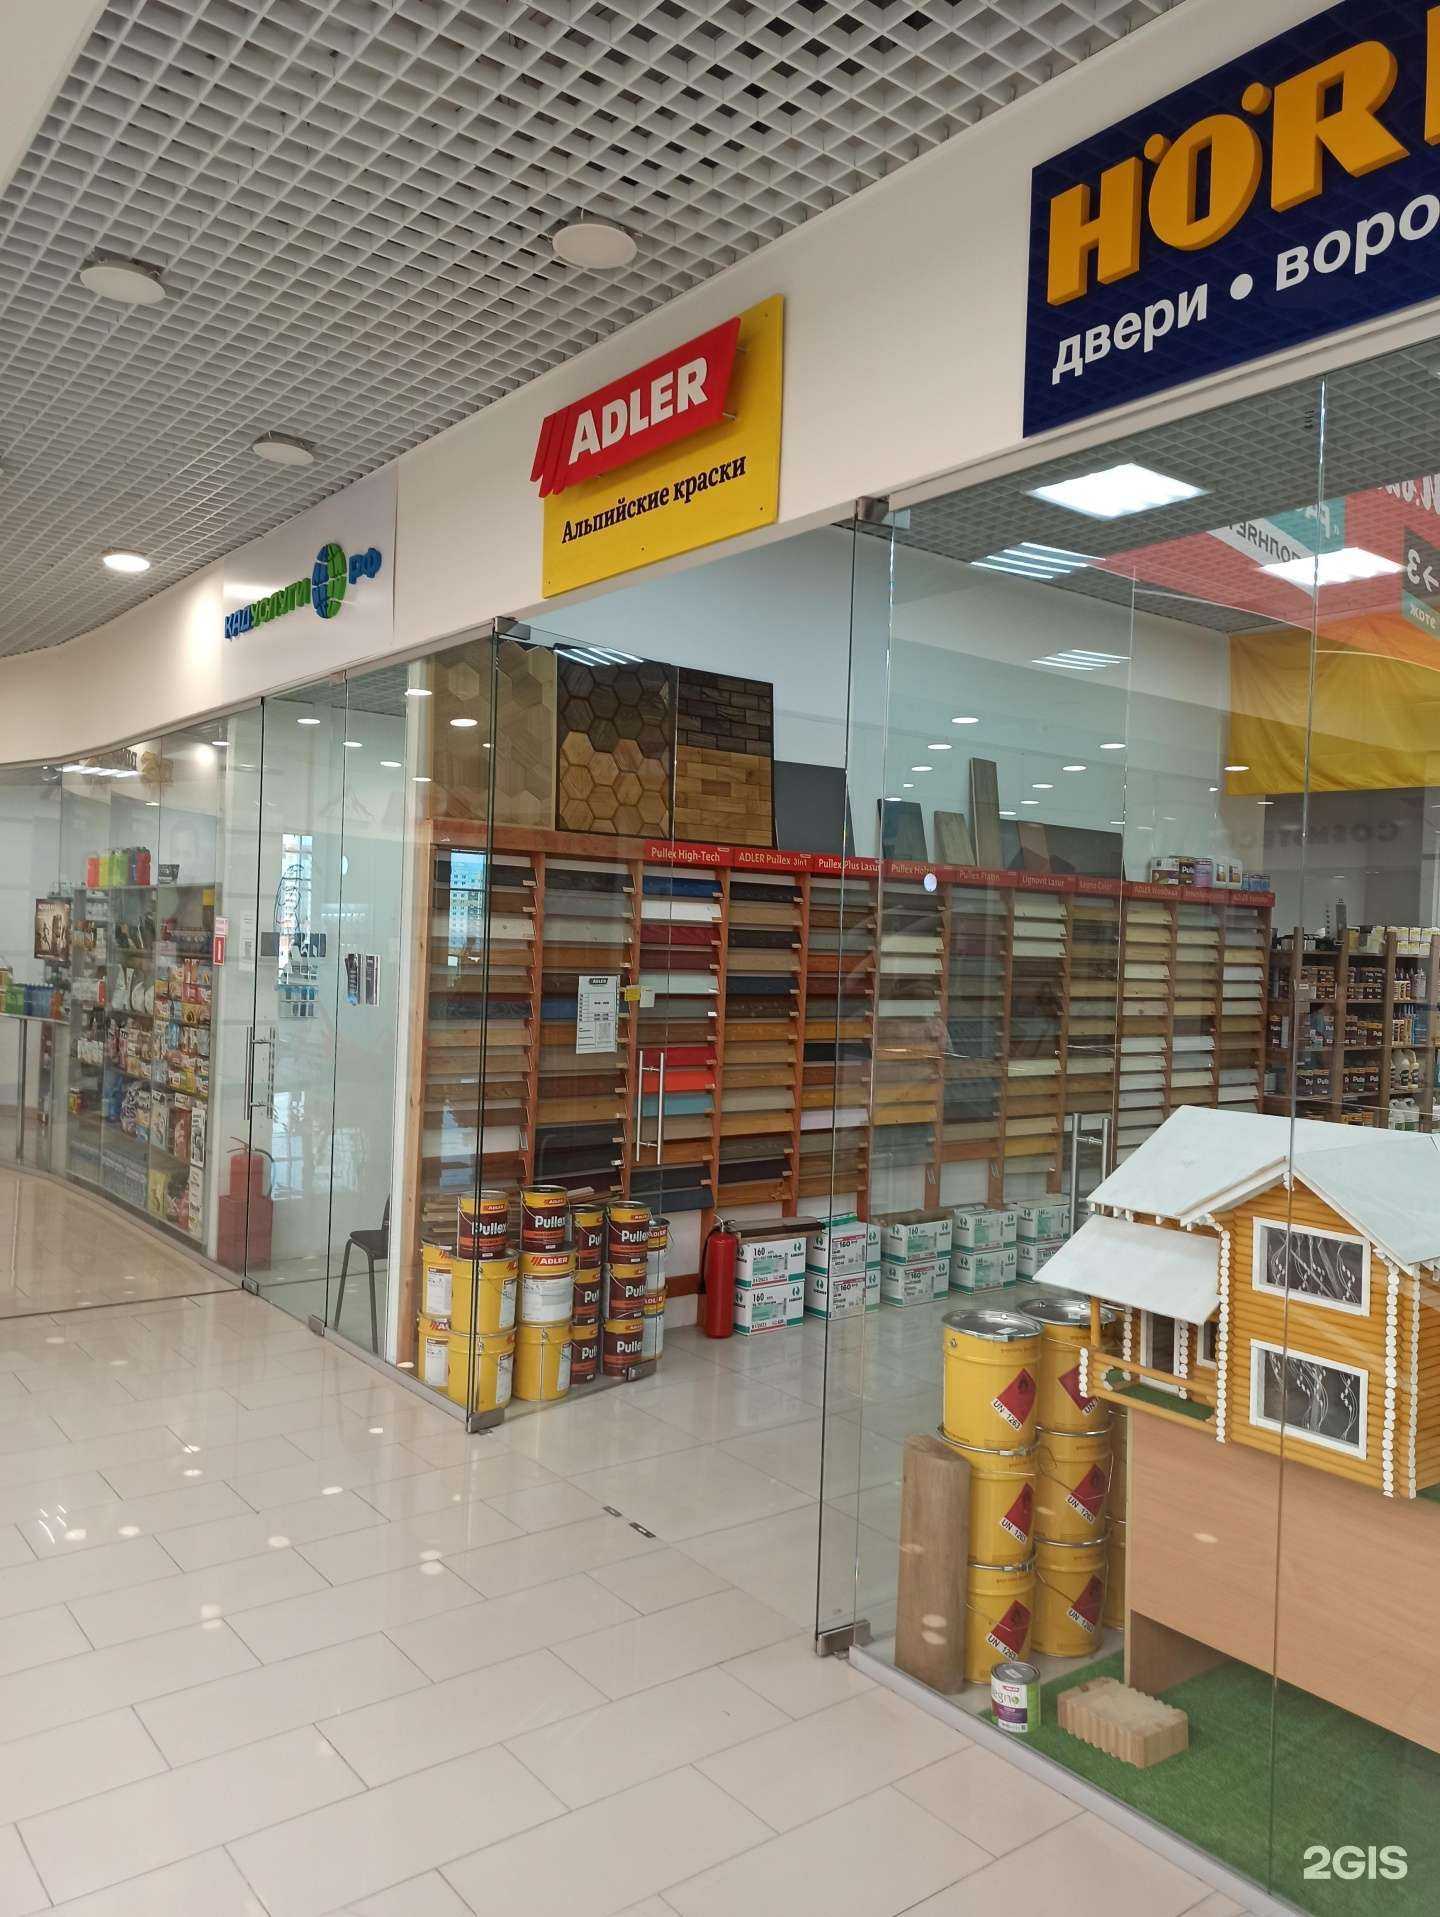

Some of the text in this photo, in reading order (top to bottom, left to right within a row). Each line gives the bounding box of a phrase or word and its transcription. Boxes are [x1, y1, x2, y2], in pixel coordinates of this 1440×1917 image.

[1047, 6, 1440, 306] HÖR
[1052, 284, 1207, 385] двери
[568, 357, 708, 466] ADLER
[561, 456, 746, 543] Альпийские краски
[652, 847, 720, 862] Pullex High-Tech
[739, 852, 765, 863] ADLER
[766, 855, 790, 865] Pullex
[818, 858, 842, 869] Pullex
[844, 861, 859, 870] Plus
[621, 1229, 648, 1243] Pulle
[753, 1247, 766, 1257] 160
[539, 1256, 568, 1265] ADLER
[625, 1285, 644, 1298] Pull
[752, 1292, 765, 1303] 160
[616, 1340, 642, 1354] Pulle
[993, 1400, 1021, 1430] UN 1263
[1067, 1496, 1080, 1509] UN
[1001, 1518, 1013, 1530] UN
[1068, 1609, 1080, 1621] UN
[987, 1634, 1000, 1648] UN
